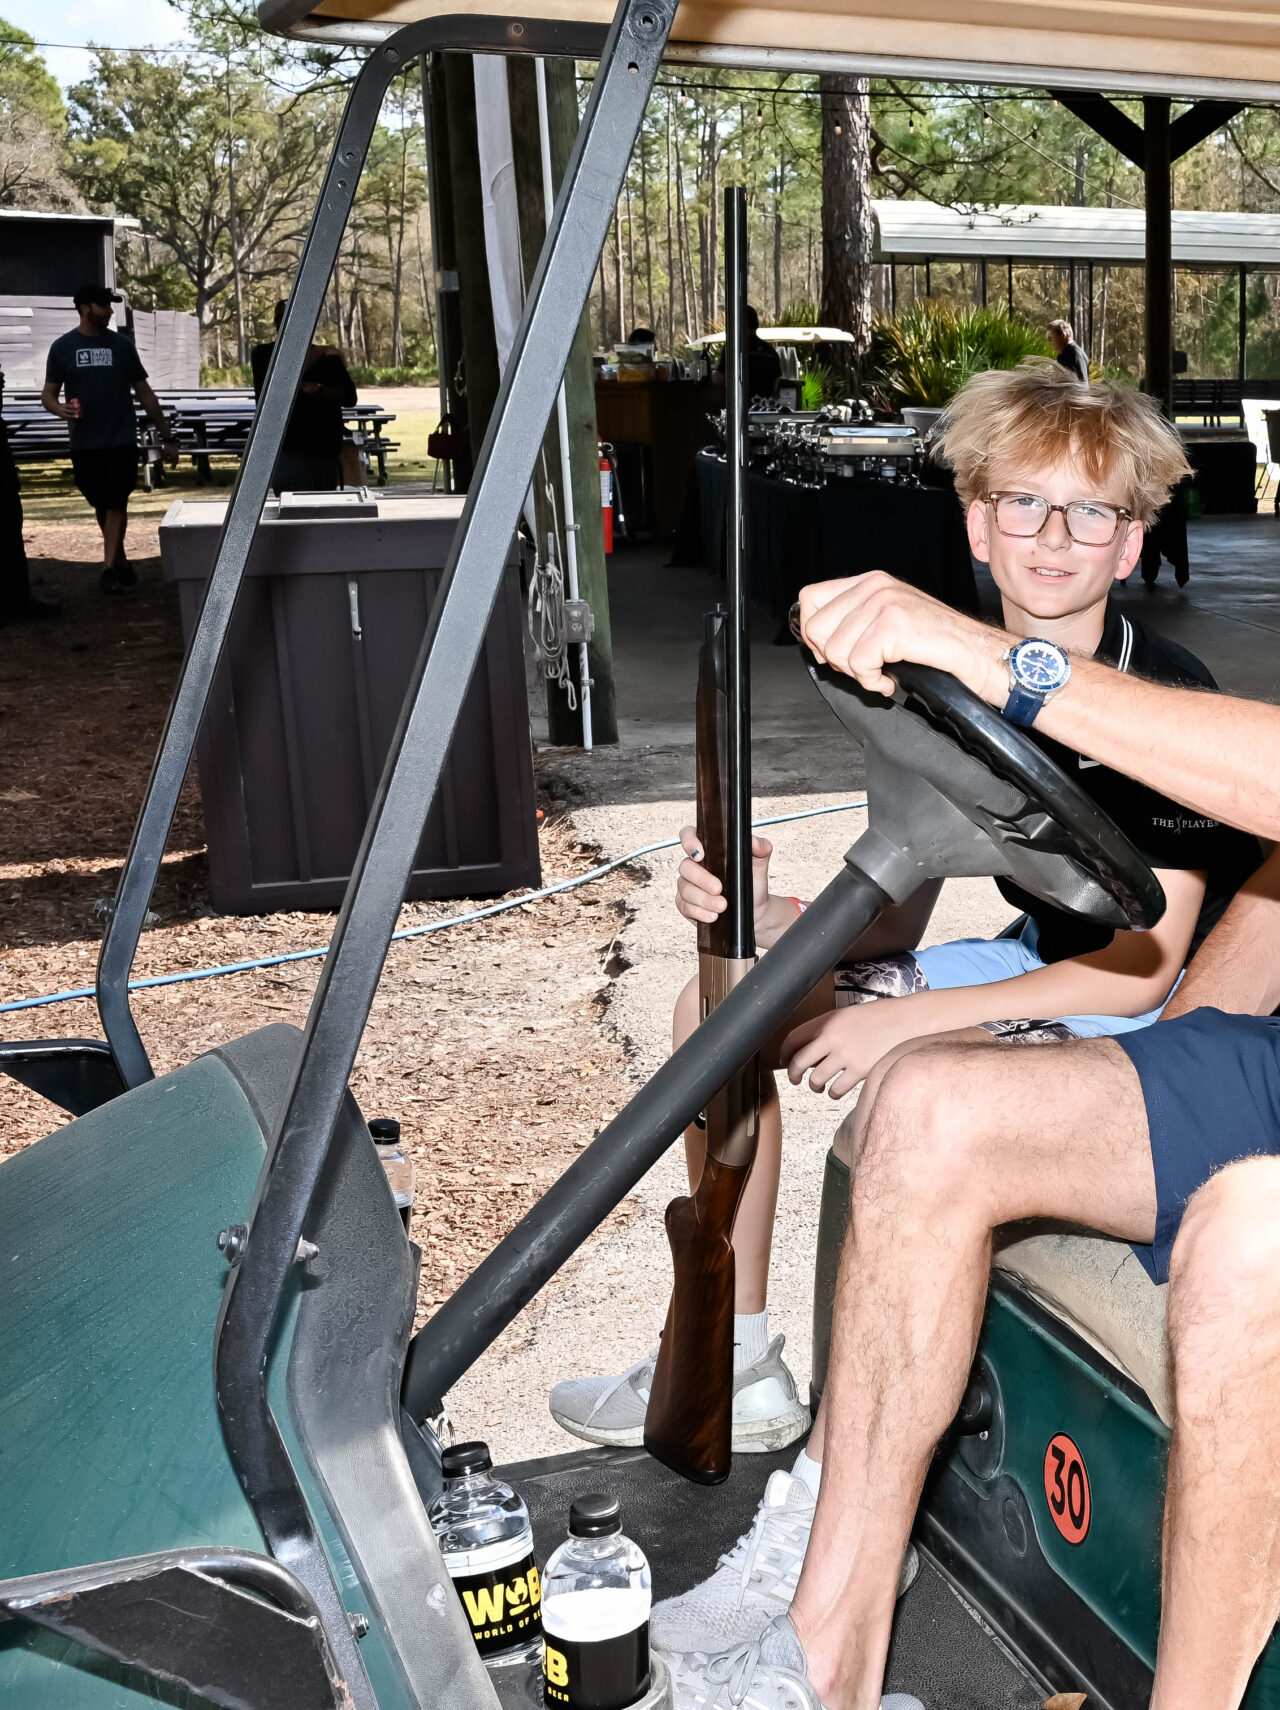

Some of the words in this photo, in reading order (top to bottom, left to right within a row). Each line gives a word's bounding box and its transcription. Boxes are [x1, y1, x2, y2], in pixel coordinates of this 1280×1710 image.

[1152, 817, 1174, 828] THE
[1050, 1443, 1086, 1530] 30
[474, 1624, 513, 1640] WORLD
[518, 1617, 530, 1629] OF
[547, 1686, 570, 1702] BEER
